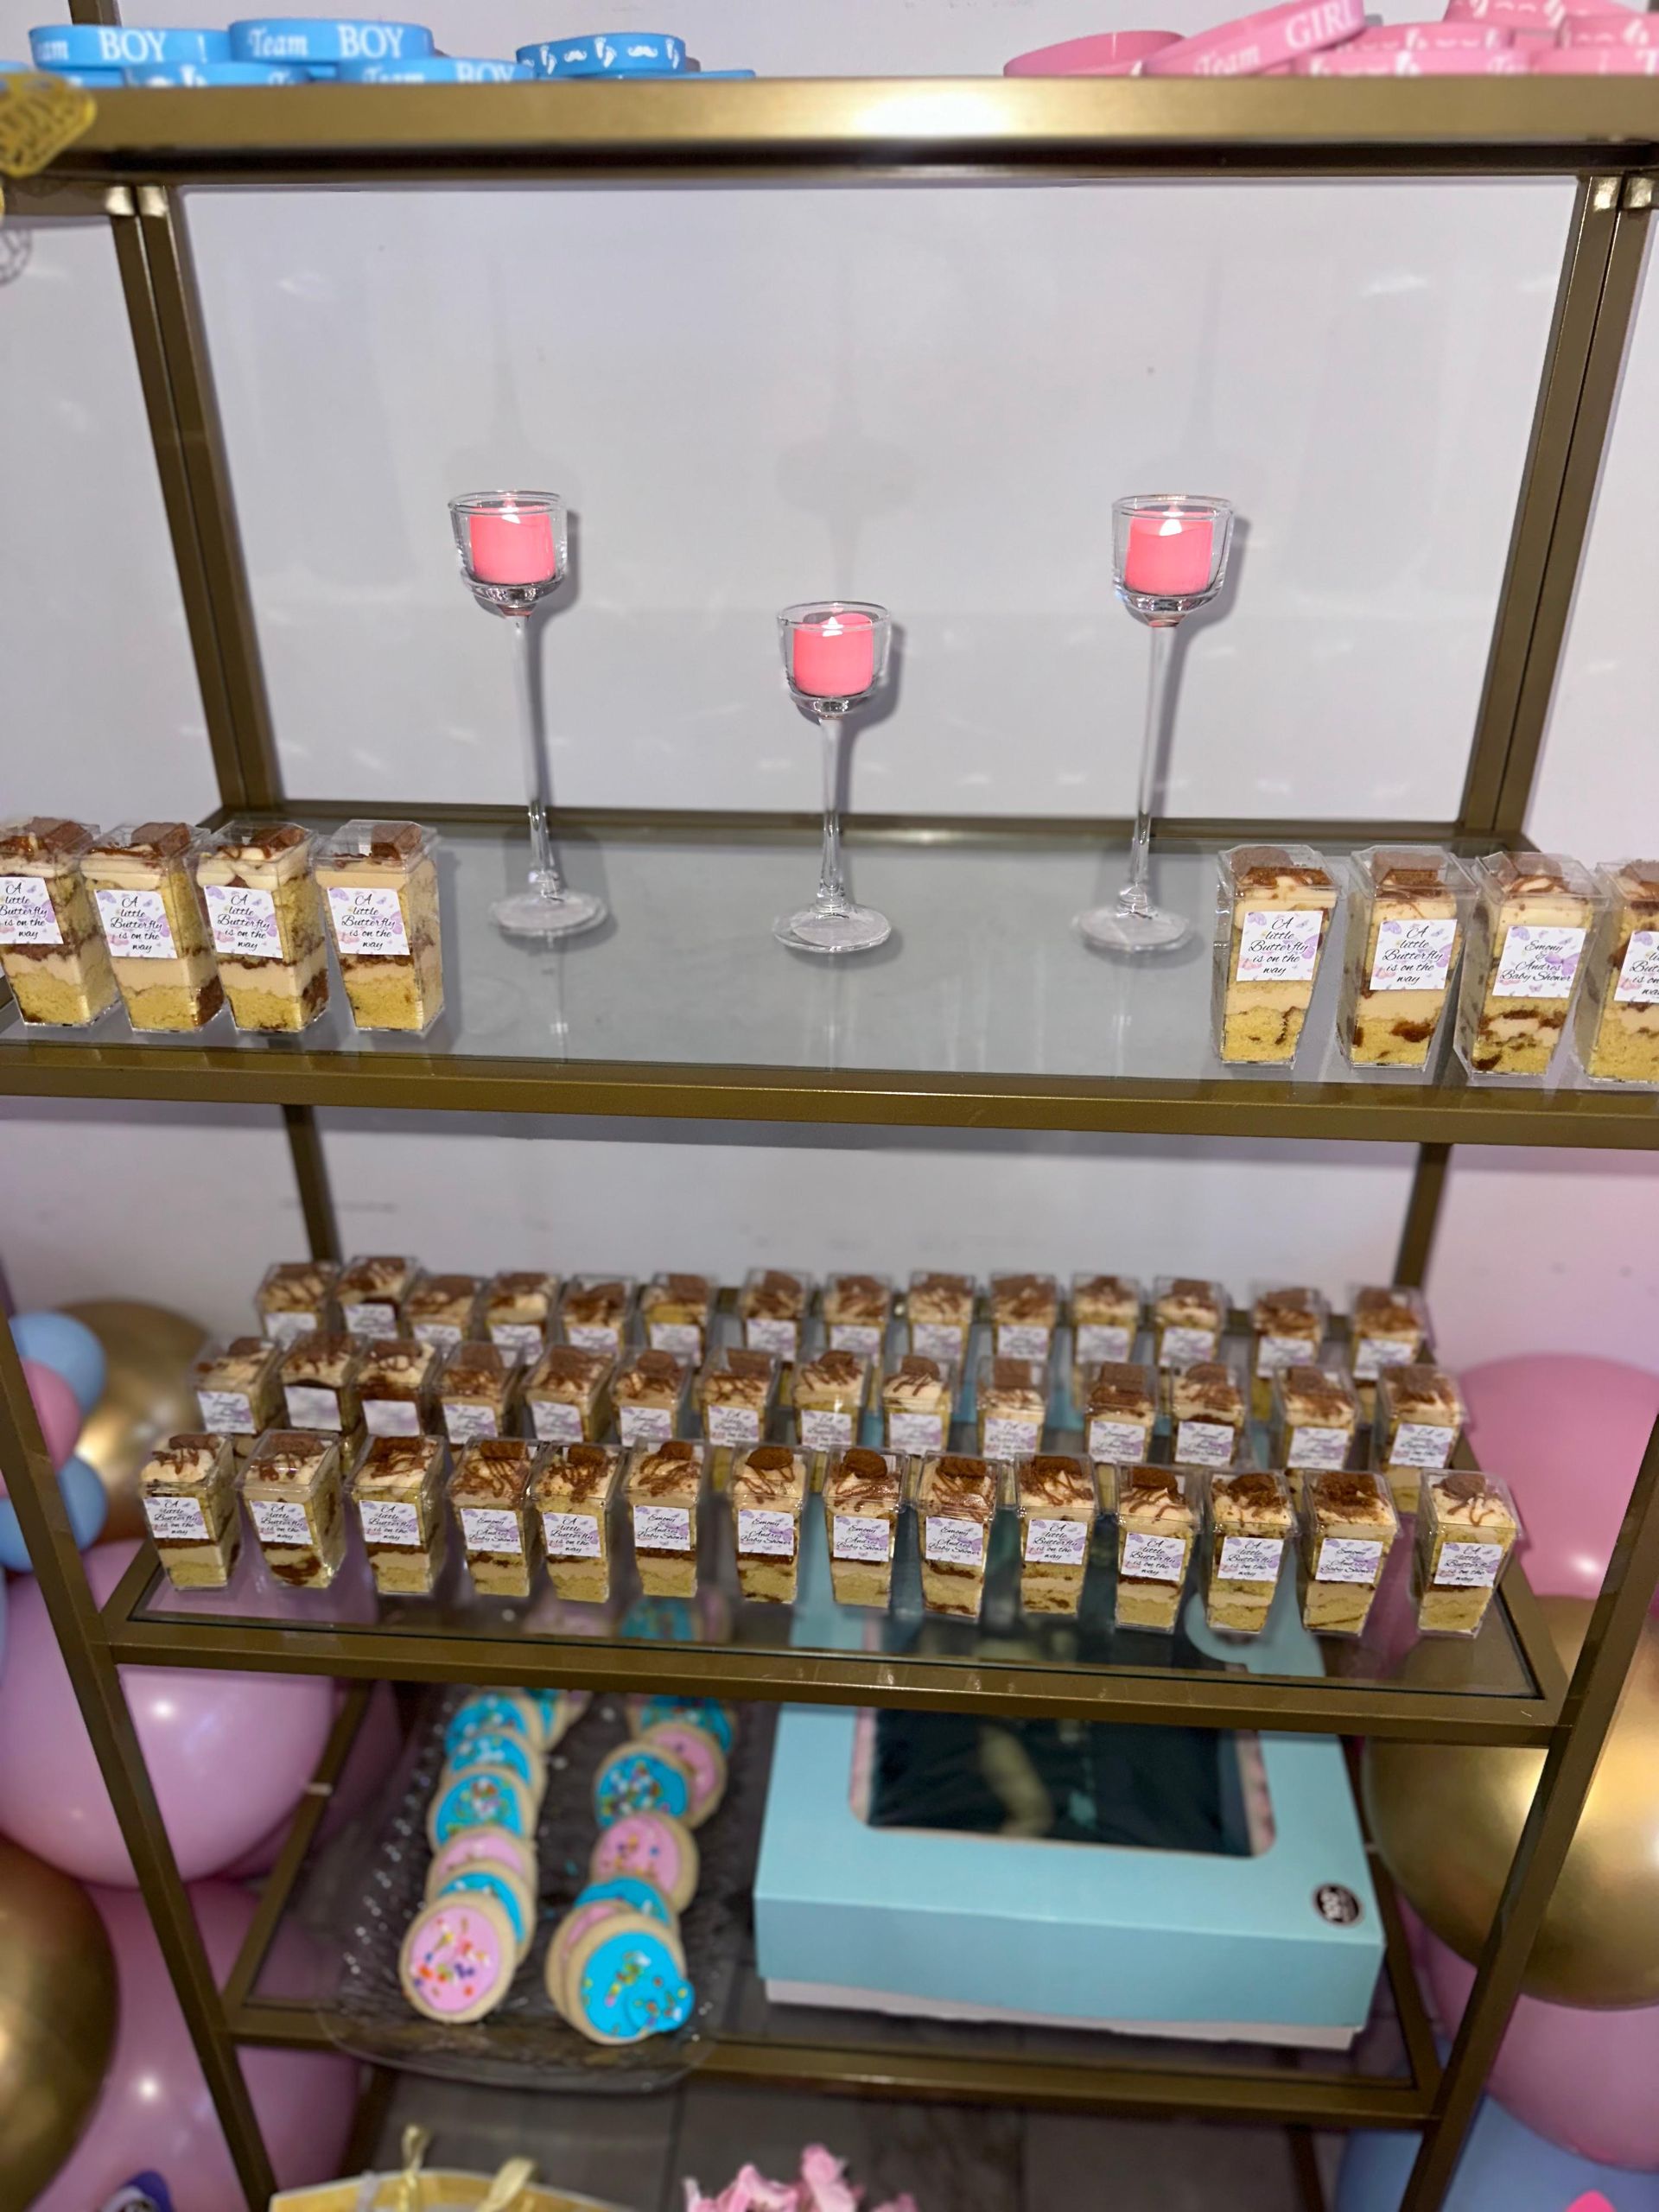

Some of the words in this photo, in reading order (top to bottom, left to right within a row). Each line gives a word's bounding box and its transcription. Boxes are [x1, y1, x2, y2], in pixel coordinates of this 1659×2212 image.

[1285, 0, 1357, 49] GIRL
[98, 29, 167, 63] BOY
[249, 27, 308, 57] Team
[336, 24, 404, 58] BOY
[6, 882, 22, 895] A
[5, 896, 29, 904] little
[122, 896, 138, 907] A
[231, 894, 248, 905] A
[355, 894, 372, 905] A
[0, 904, 47, 918] Butterfly
[121, 909, 145, 918] little
[229, 906, 254, 916] little
[353, 907, 379, 915] little
[110, 917, 162, 931] Butterfly
[217, 914, 270, 930] Butterfly
[341, 915, 395, 928] Butterfly
[1271, 917, 1294, 929] A
[19, 931, 38, 940] way
[144, 932, 159, 940] the
[251, 930, 266, 939] the
[376, 929, 391, 937] the
[1265, 931, 1294, 939] little
[1406, 925, 1429, 938] A
[132, 944, 152, 953] way
[238, 942, 258, 951] way
[363, 942, 383, 950] way
[1248, 940, 1308, 952] Butterfly
[1400, 940, 1429, 948] little
[1282, 954, 1300, 962] the
[1382, 949, 1443, 961] Butterfly
[1263, 967, 1286, 976] way
[1416, 962, 1434, 971] the
[1501, 969, 1531, 981] Baby
[1532, 973, 1571, 981] Shower
[1397, 976, 1420, 985] way
